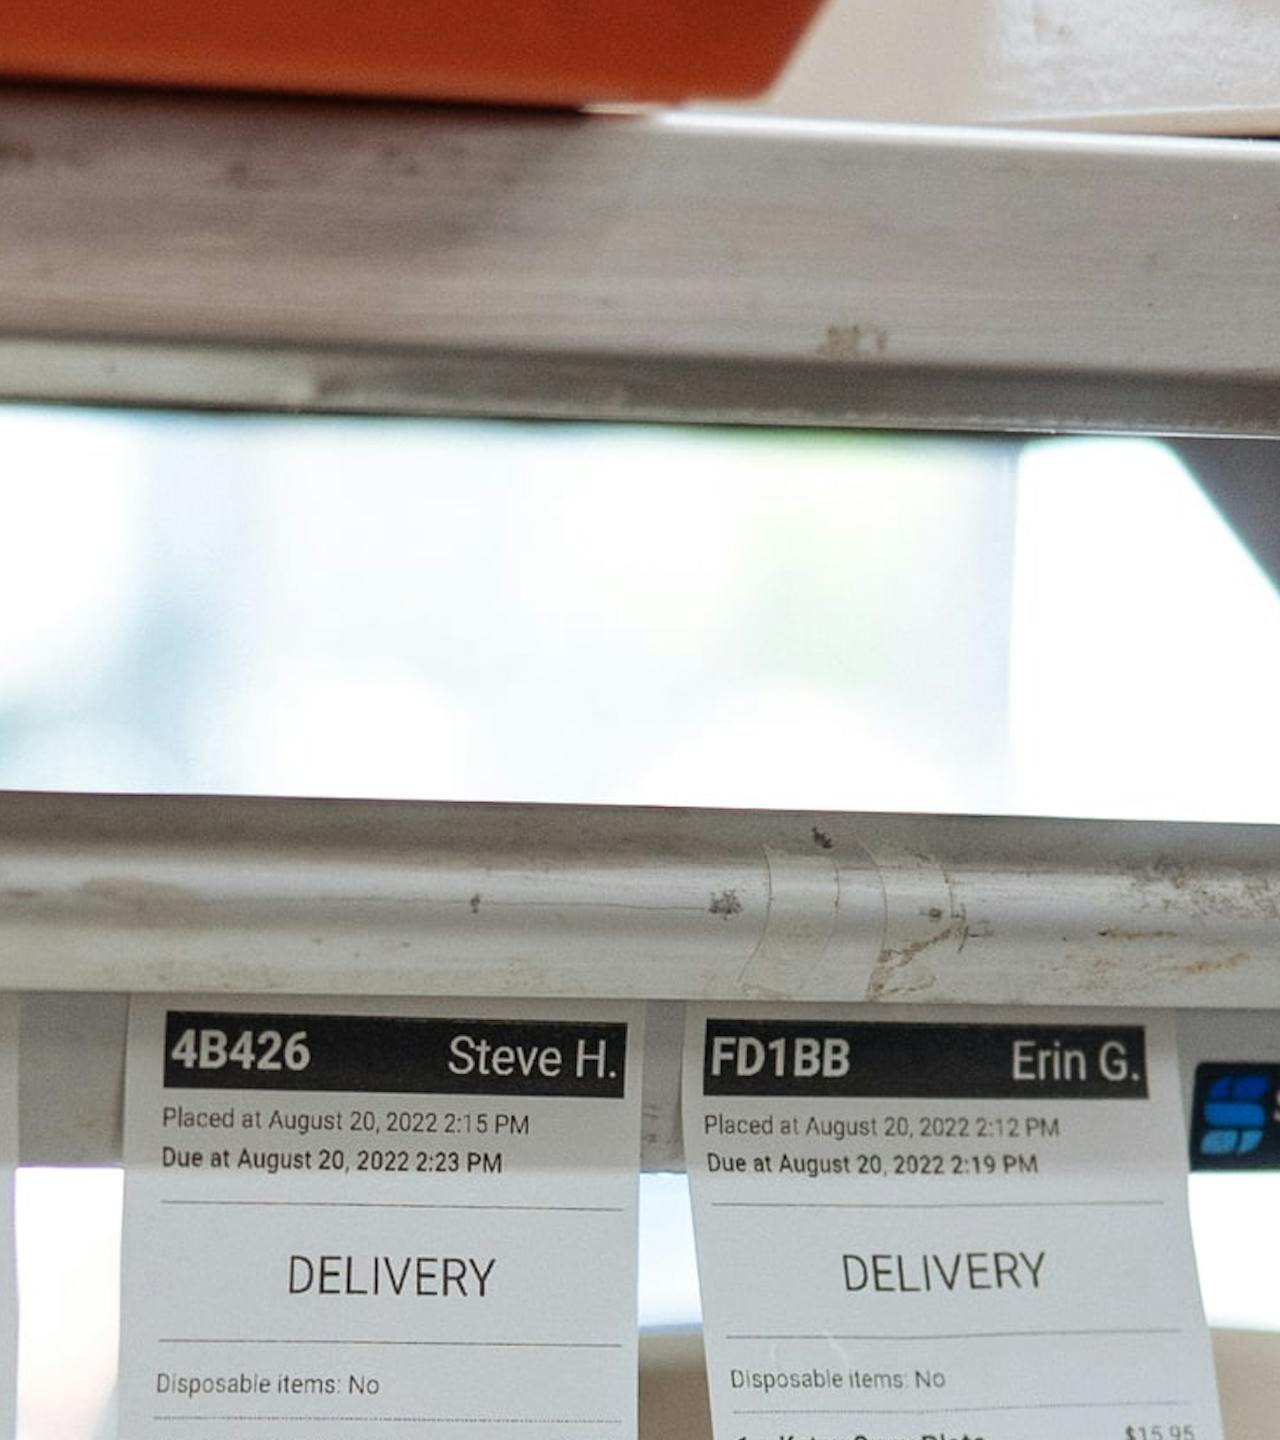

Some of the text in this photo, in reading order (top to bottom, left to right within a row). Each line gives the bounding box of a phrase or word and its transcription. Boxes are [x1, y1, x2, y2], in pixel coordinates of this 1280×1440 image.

[171, 1029, 617, 1078] 4B426 Steve H.
[711, 1036, 1139, 1082] FD1BB Erin G.
[162, 1105, 529, 1136] Placed at August 20, 2022 2:15 PM
[162, 1146, 502, 1174] Due at August 20, 2022 2:23 PM
[289, 1255, 496, 1297] DELIVERY
[842, 1251, 1045, 1292] DELIVERY
[156, 1372, 380, 1399] Disposable items: No
